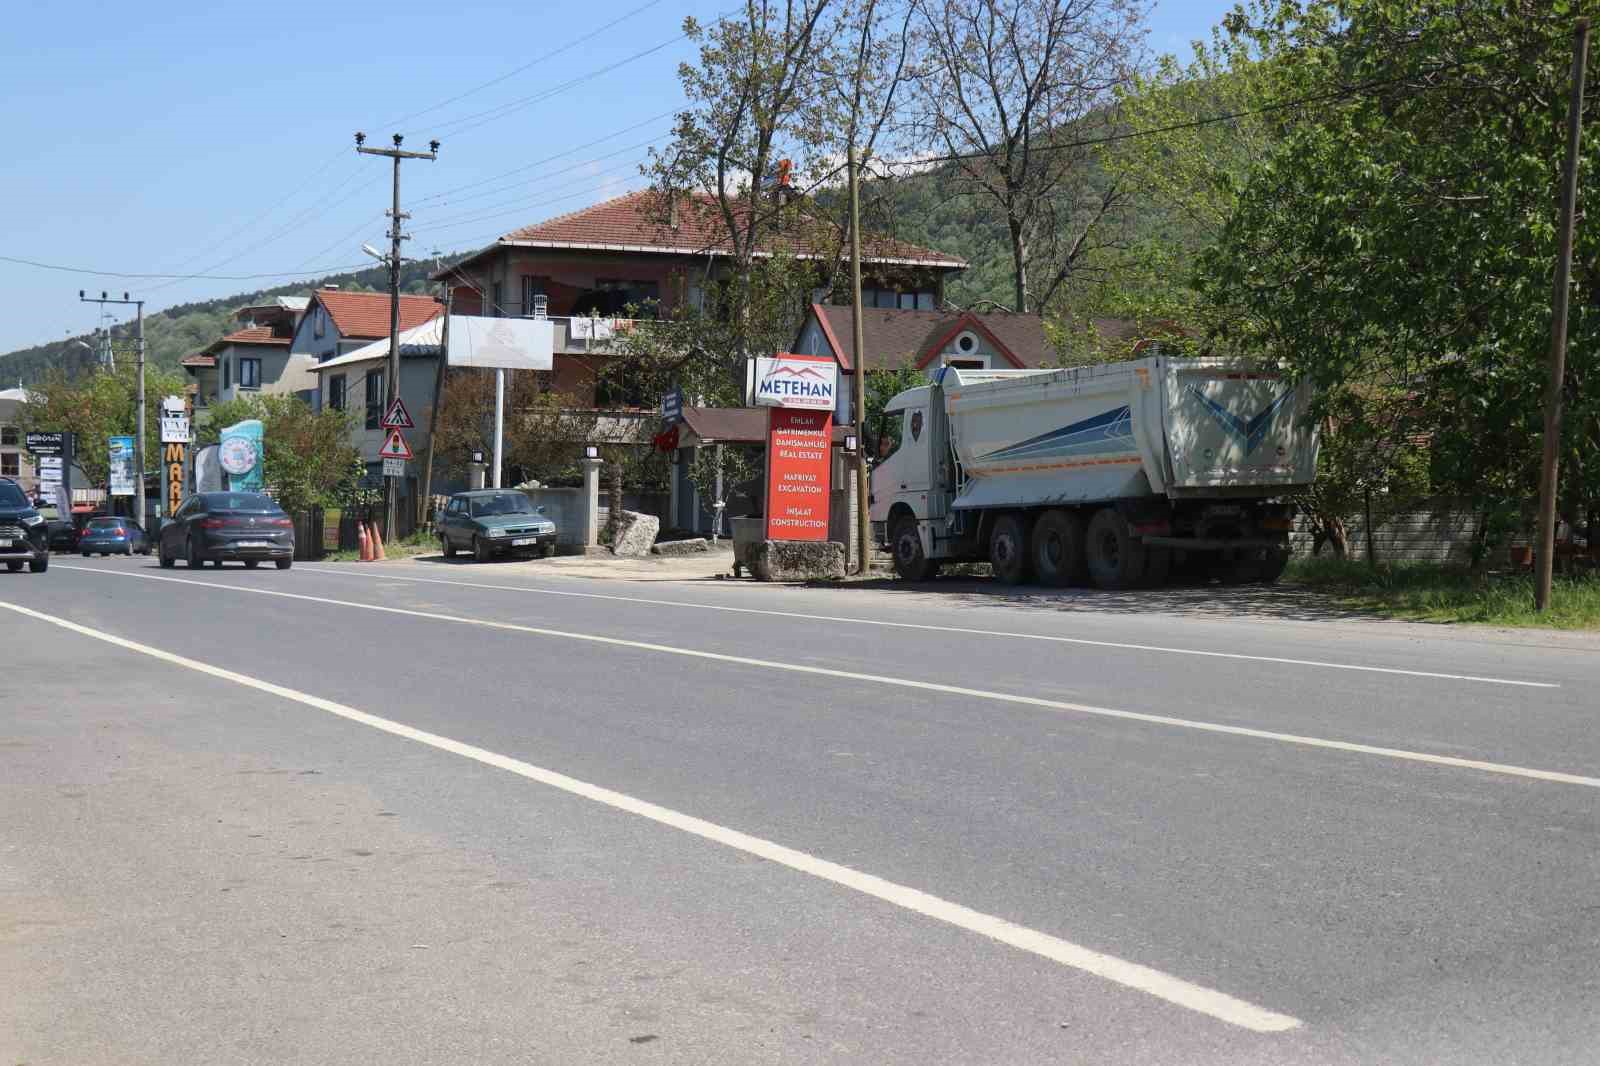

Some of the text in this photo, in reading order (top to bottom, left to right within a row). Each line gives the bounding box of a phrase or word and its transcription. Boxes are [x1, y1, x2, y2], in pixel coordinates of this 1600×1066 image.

[760, 379, 832, 397] METEHAN
[799, 451, 823, 460] ESTATE
[778, 484, 822, 494] EXCAVATION
[771, 518, 827, 529] CONSTRUCTION
